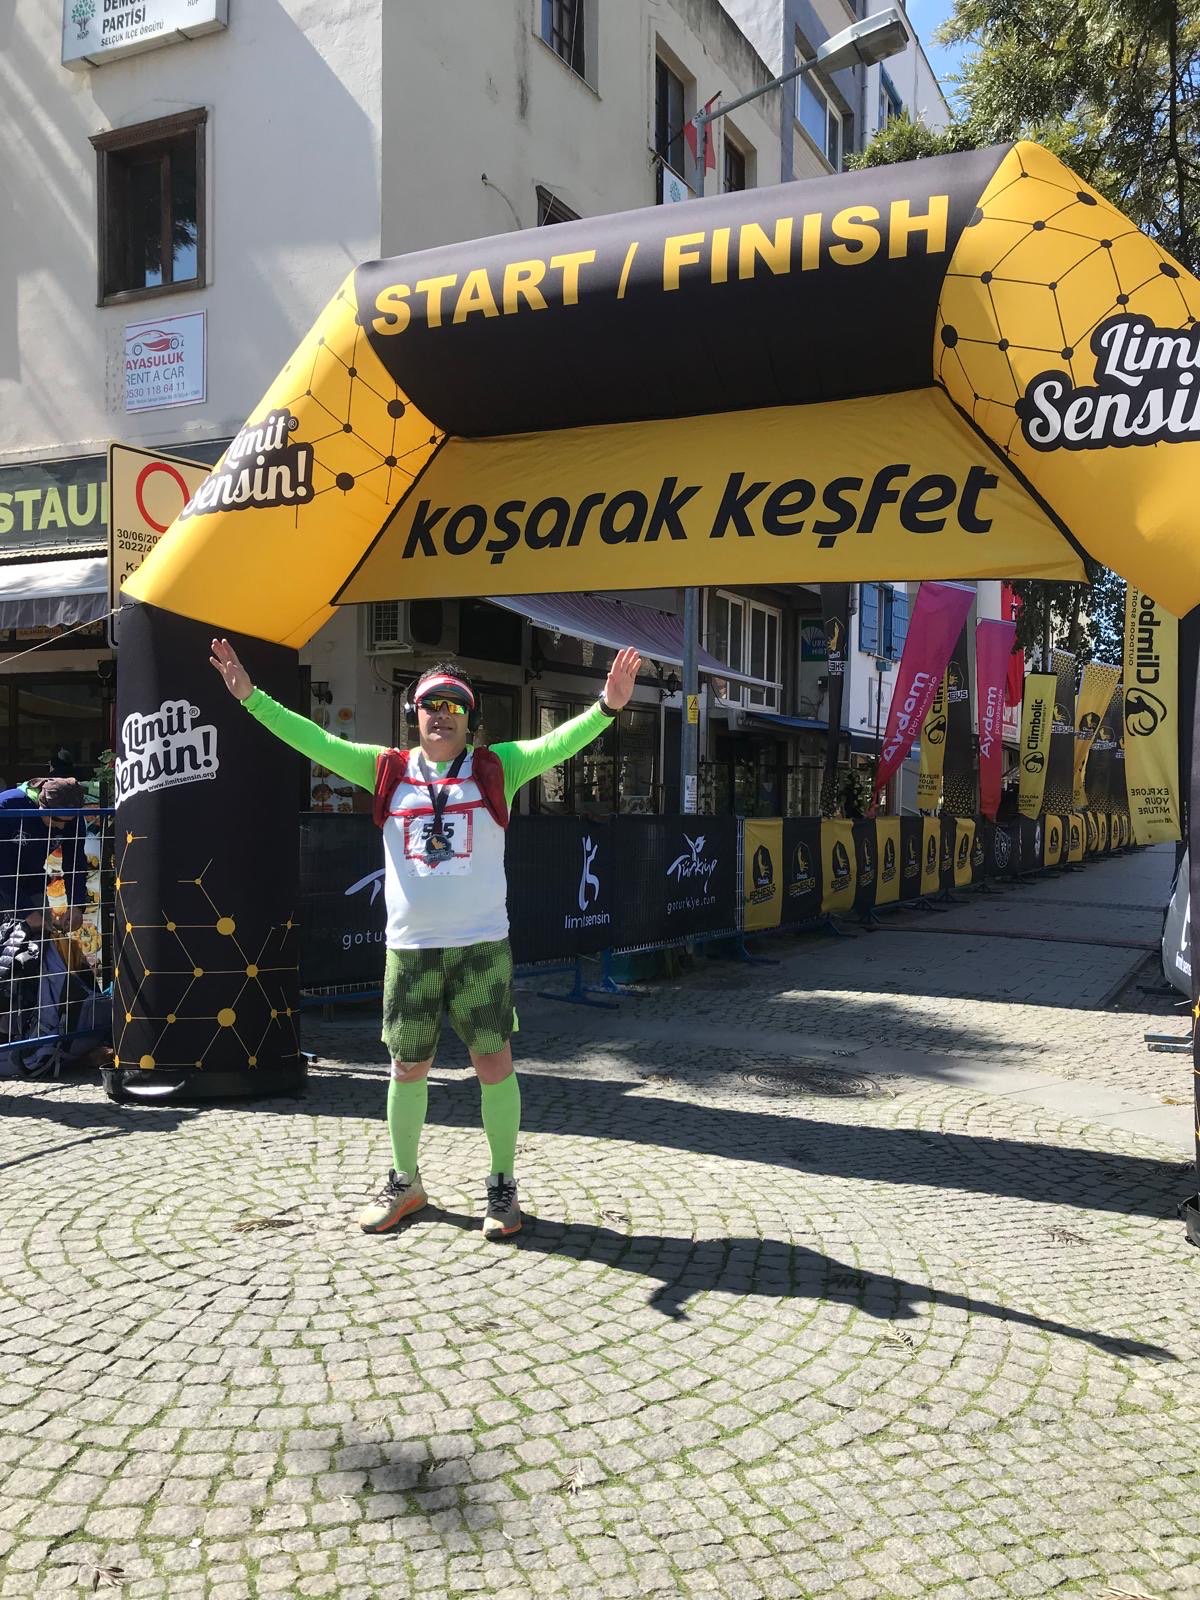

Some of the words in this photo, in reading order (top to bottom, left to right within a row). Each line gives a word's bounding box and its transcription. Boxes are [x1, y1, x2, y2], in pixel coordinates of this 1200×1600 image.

[102, 5, 146, 34] PARTİSİ
[371, 249, 597, 336] START
[616, 241, 640, 299] /
[662, 194, 949, 291] FINISH
[126, 351, 184, 371] AYASULUK
[153, 370, 160, 381] A
[162, 365, 185, 380] CAR
[402, 476, 704, 564] koşarak
[709, 463, 999, 548] keşfet
[116, 528, 162, 545] 30/06/20
[118, 540, 155, 553] 2022/4
[125, 705, 188, 756] Limit
[980, 686, 998, 759] Aydem
[1027, 699, 1044, 751] Climbolic
[148, 770, 215, 791] www.limitsensin.org
[421, 822, 455, 841] 55
